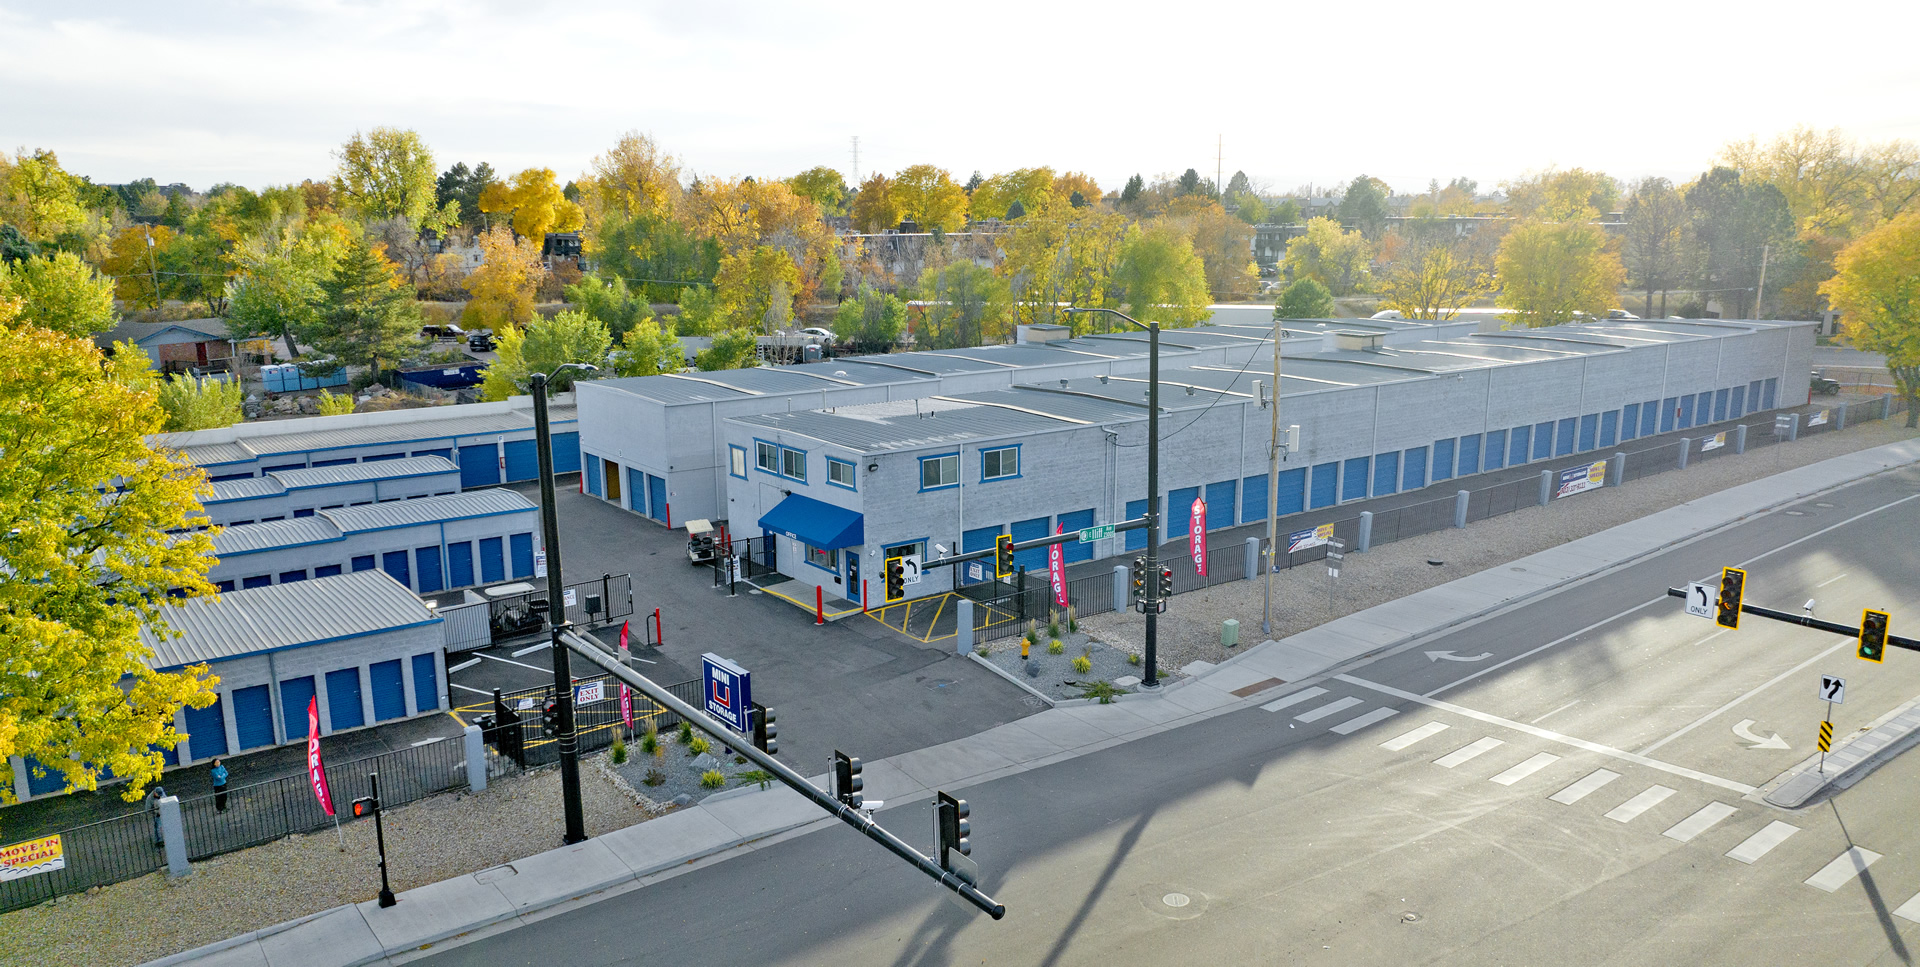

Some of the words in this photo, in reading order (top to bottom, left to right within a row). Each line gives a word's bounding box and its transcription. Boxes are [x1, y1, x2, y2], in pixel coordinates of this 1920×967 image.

[1092, 528, 1103, 539] Iliff
[1690, 606, 1708, 615] ONLY
[712, 666, 729, 685] MINI
[580, 688, 599, 696] EXIT
[713, 680, 730, 709] U
[708, 700, 737, 723] STORAGE
[4, 849, 57, 867] SPECIAL
